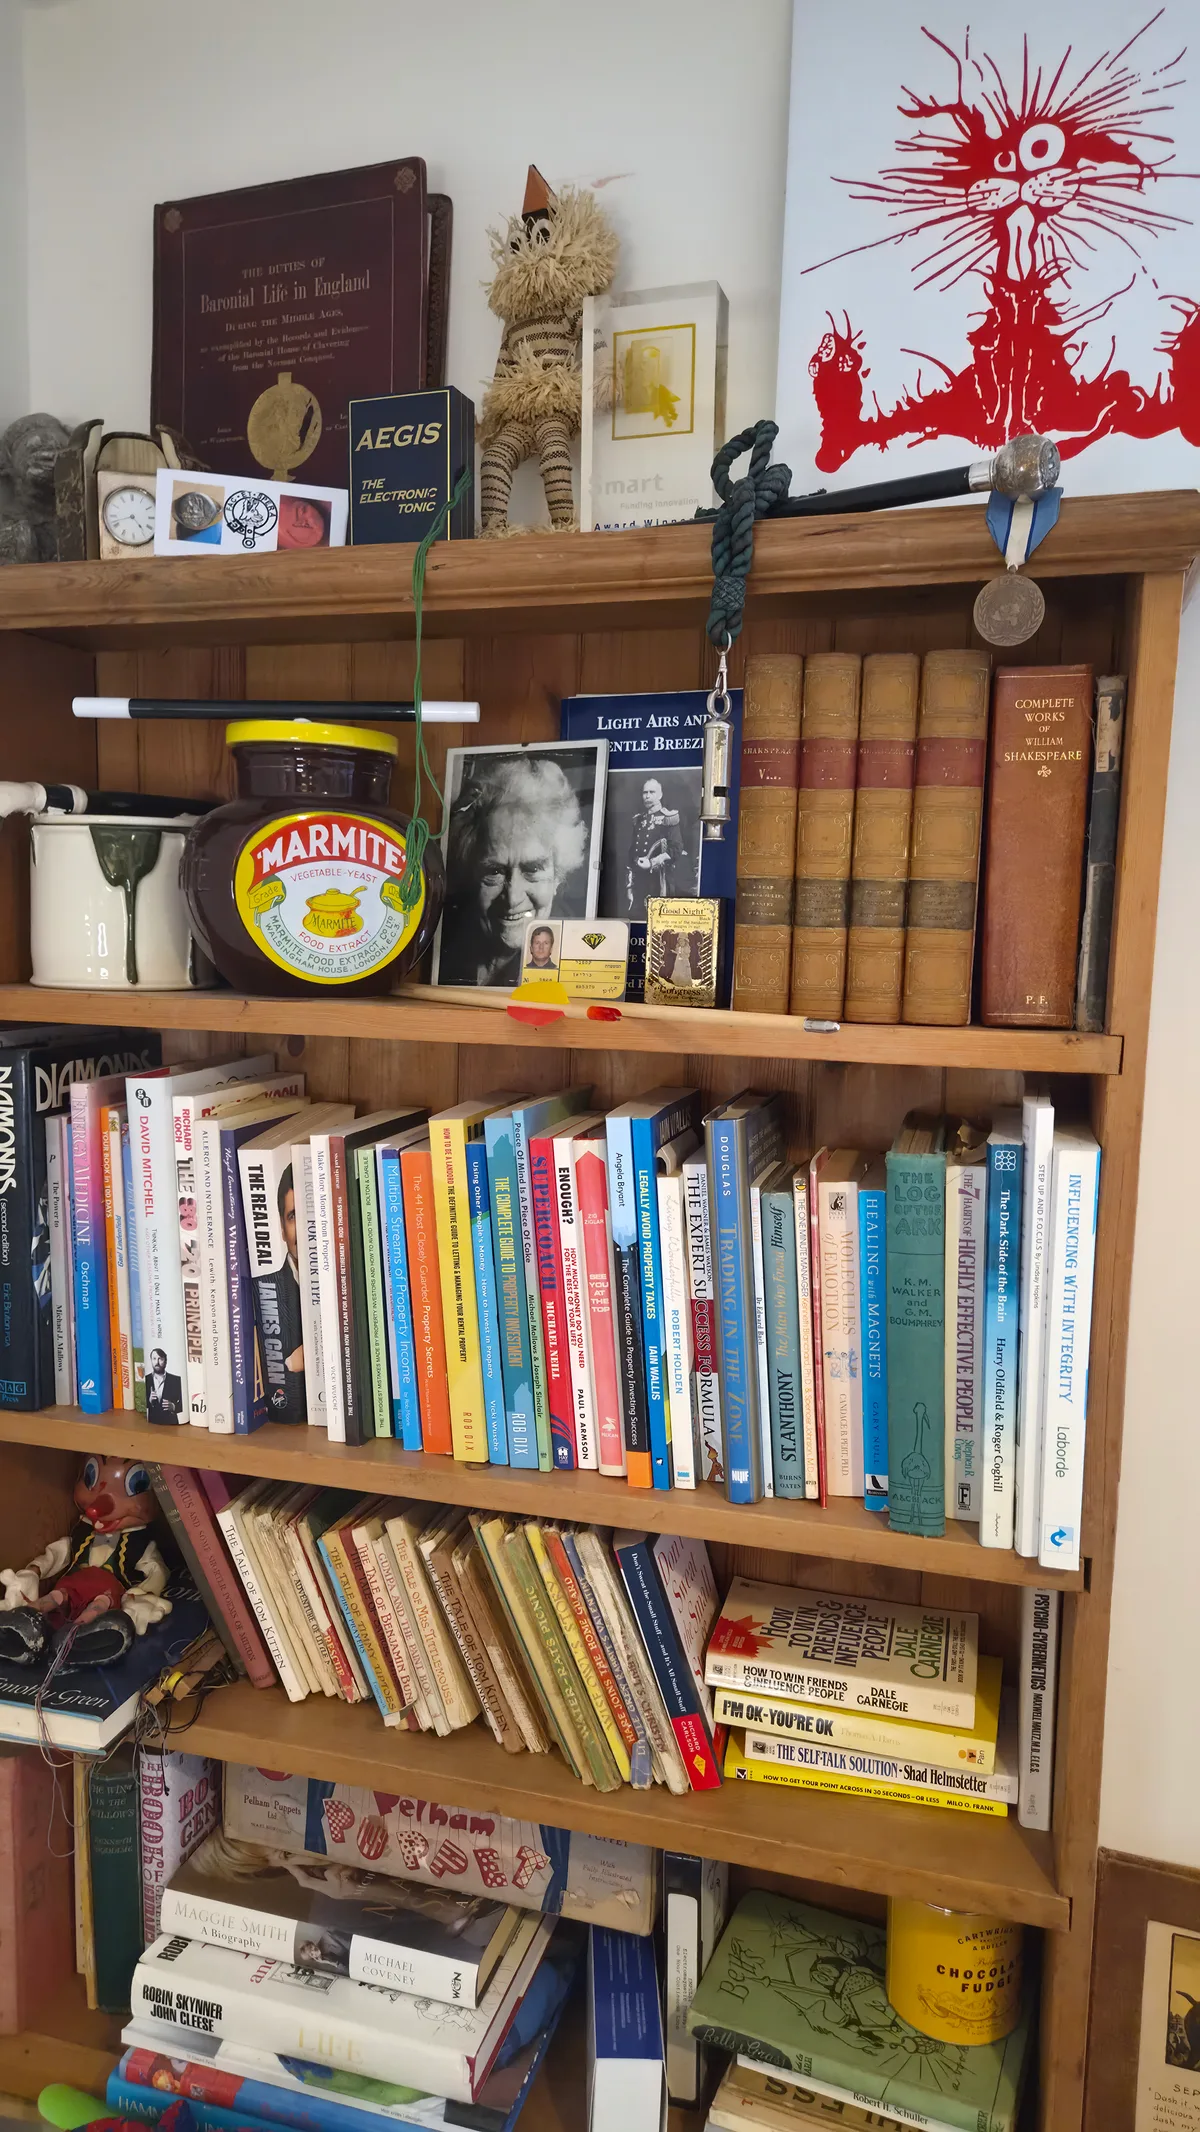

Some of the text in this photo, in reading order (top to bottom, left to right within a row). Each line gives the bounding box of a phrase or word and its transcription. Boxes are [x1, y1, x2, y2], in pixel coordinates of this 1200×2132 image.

[242, 257, 325, 278] THE DUTIES OF
[201, 270, 370, 313] Baronial Life in England
[355, 422, 442, 451] AEGIS
[359, 487, 437, 504] ELECTRONIC
[362, 478, 385, 490] THE
[225, 494, 237, 512] FAC
[398, 501, 435, 514] TONIC
[1014, 697, 1074, 710] COMPLETE
[1024, 711, 1065, 723] WORKS
[597, 716, 642, 731] LIGHT
[646, 713, 680, 728] AIRS
[1038, 724, 1051, 733] OF
[606, 737, 705, 753] ENTLE BREEZ
[1004, 750, 1083, 762] SHAKESPEARE
[1024, 736, 1064, 747] WILLIAM
[306, 913, 356, 931] MARMITE
[265, 922, 315, 970] WALSINGHAM
[270, 915, 305, 956] MARMITE
[308, 953, 334, 965] FOOD
[339, 942, 380, 965] EXTRACT
[299, 930, 372, 953] FOOD EXTRACT
[0, 1066, 16, 1194] DIAMONDS
[174, 1116, 182, 1143] KOCH
[182, 1108, 192, 1151] RICHARD
[72, 1100, 91, 1246] ENERGY MEDICINE
[139, 1116, 154, 1218] DAVID MITCHELL
[615, 1152, 625, 1207] Angela Bryant
[558, 1167, 574, 1225] ENOUGH?
[248, 1164, 273, 1266] THE REAL DEAL
[532, 1156, 556, 1290] SUPERCOACH
[639, 1170, 656, 1320] LEGALLY AVOID PROPERTY TAXES
[866, 1199, 879, 1276] HEALING
[495, 1176, 523, 1368] THE COMPLETE GUIDE TO PROPERTY INVESTMENT
[997, 1189, 1010, 1322] The Dark Side of the Brain
[81, 1261, 90, 1310] Oschman
[622, 1275, 631, 1311] Complete
[1059, 1174, 1082, 1404] INFLUENCING WITH INTEGRITY
[687, 1173, 715, 1436] THE EXPERT SUCCESS FORMULA
[258, 1281, 286, 1385] JAMES CAAN
[546, 1301, 560, 1380] MICHAEL NEILL
[626, 1337, 631, 1345] to
[868, 1303, 881, 1379] MAGNETS
[955, 1238, 976, 1433] HIGHLY EFFECTIVE PEOPLE
[626, 1347, 634, 1379] Property
[648, 1345, 661, 1400] IAIN WALLIS
[629, 1417, 637, 1445] Success
[1055, 1426, 1070, 1478] Laborde
[225, 1525, 286, 1668] THE TALE OF TOM KITTEN
[1031, 1593, 1050, 1691] PSYCHO-CYBERNETICS
[743, 1665, 848, 1691] HOW TO WIN FRIENDS
[743, 1676, 845, 1702] & INFLUENCE PEOPLE
[871, 1687, 896, 1700] DALE
[722, 1700, 743, 1719] I'M
[815, 1717, 834, 1736] OK
[856, 1695, 909, 1712] CARNEGIE
[681, 1721, 694, 1752] CARLSON
[688, 1721, 700, 1750] RICHARD
[777, 1744, 898, 1779] THE SELF-TALK SOLUTION
[903, 1765, 988, 1793] Shad Helmstetter
[244, 1795, 301, 1815] Pelham Puppets
[174, 1902, 288, 1942] MAGGIE SMITH
[201, 1927, 261, 1950] A Biography
[362, 1966, 415, 1985] COVENEY
[364, 1953, 414, 1973] MICHAEL
[142, 1984, 222, 2020] ROBIN SKYNNER
[151, 2003, 214, 2032] JOHN CLEESE
[853, 2092, 928, 2125] Robert H. Schuller
